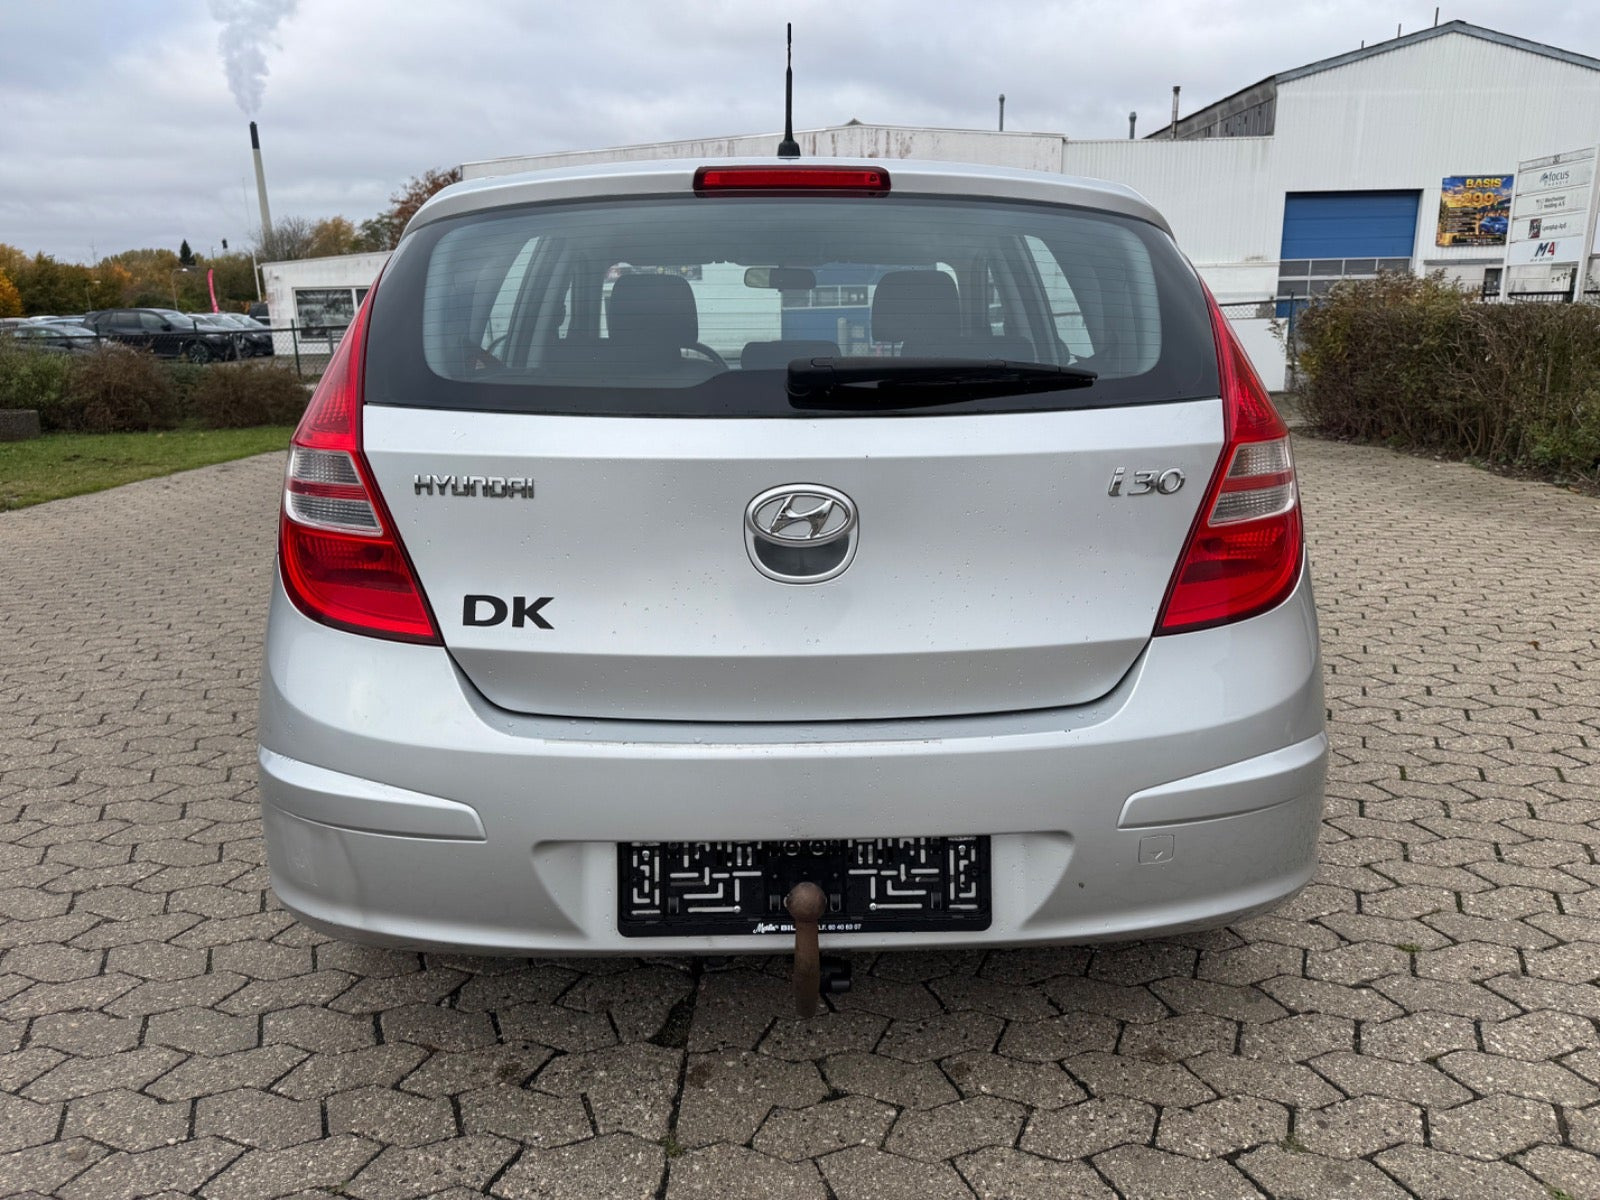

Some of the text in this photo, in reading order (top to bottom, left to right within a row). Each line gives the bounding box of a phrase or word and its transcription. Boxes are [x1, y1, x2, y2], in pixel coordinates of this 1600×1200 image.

[1466, 178, 1502, 188] BASIS
[414, 474, 535, 499] HYUNDAI
[462, 594, 555, 631] DK
